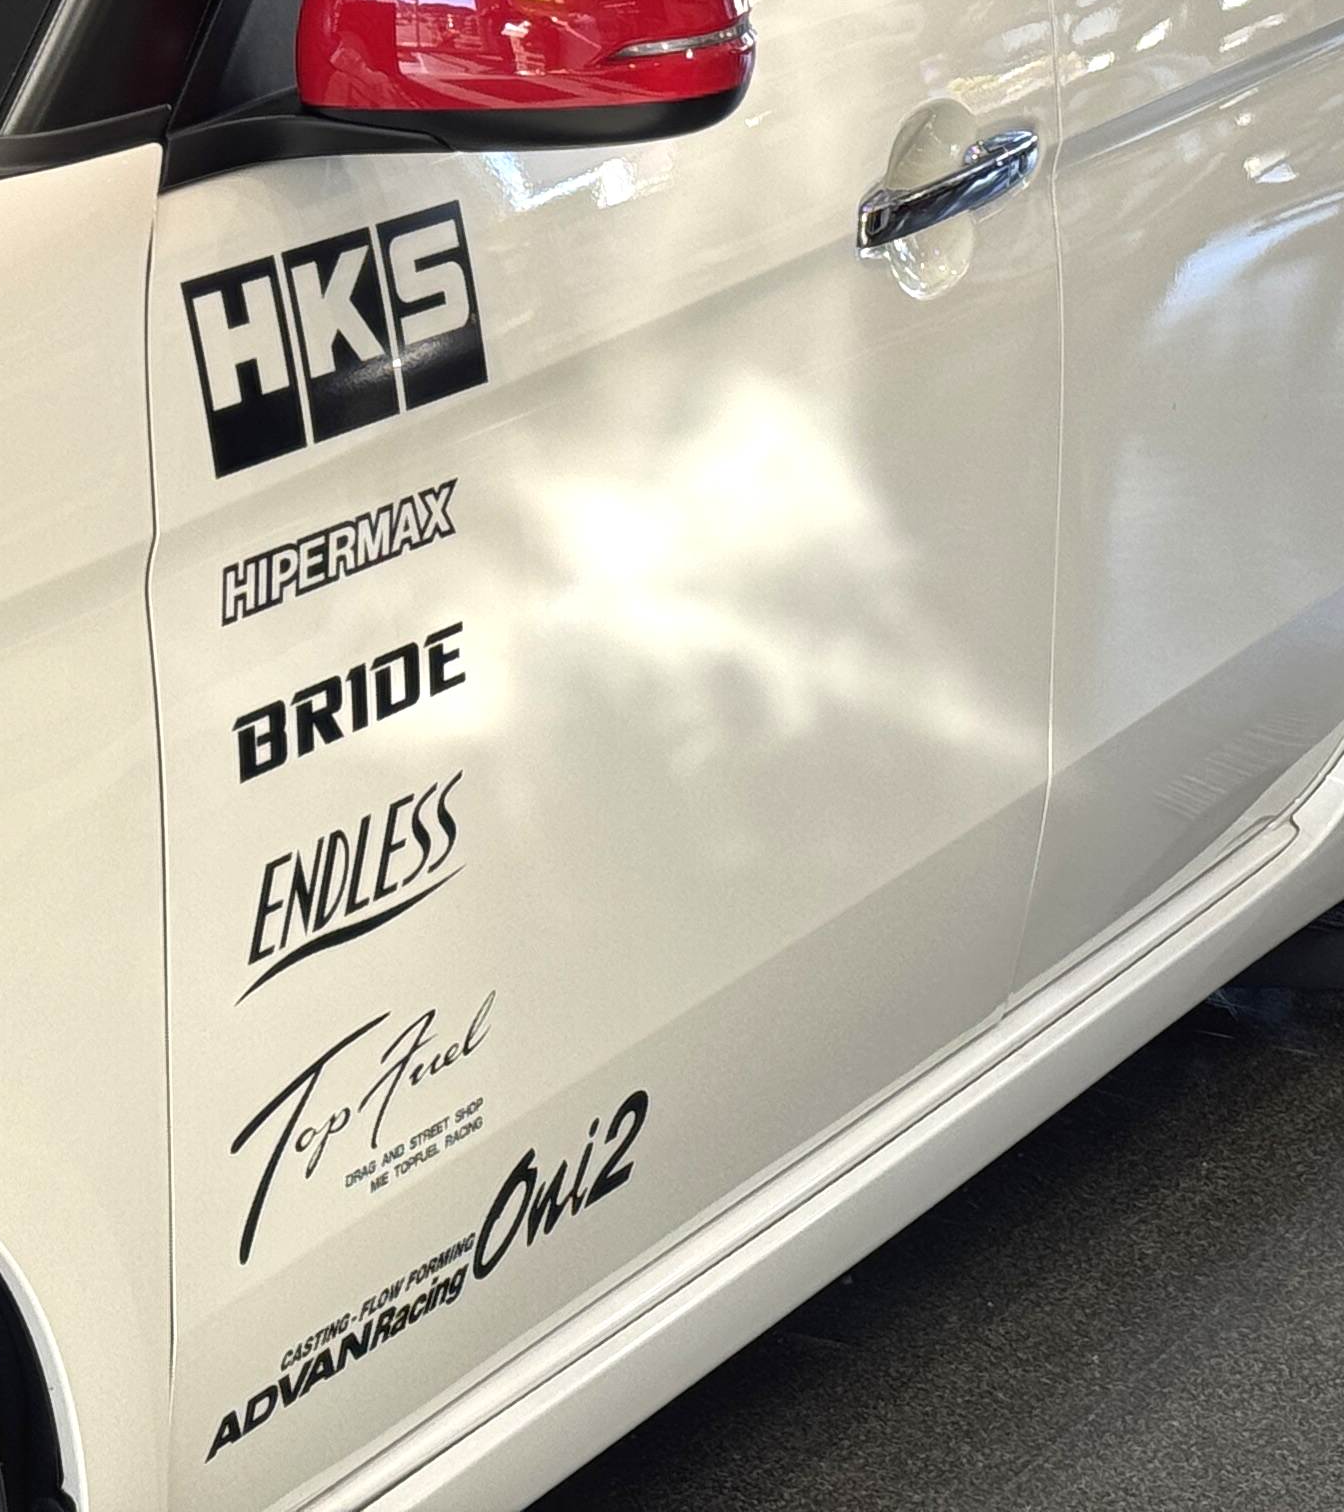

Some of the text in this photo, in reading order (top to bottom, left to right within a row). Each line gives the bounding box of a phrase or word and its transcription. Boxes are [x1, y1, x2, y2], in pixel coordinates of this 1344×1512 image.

[186, 210, 478, 433] HKS
[221, 477, 458, 626] HIPERMAX
[232, 621, 466, 784] BRIDE
[246, 770, 463, 968] ENDLESS
[230, 989, 496, 1265] Top Fuel
[344, 1096, 484, 1188] DRAG AND STREET SHOP
[370, 1116, 484, 1193] MIE TOPFUEL RACING
[472, 1088, 649, 1281] Oni2
[405, 1232, 476, 1292] FORMING
